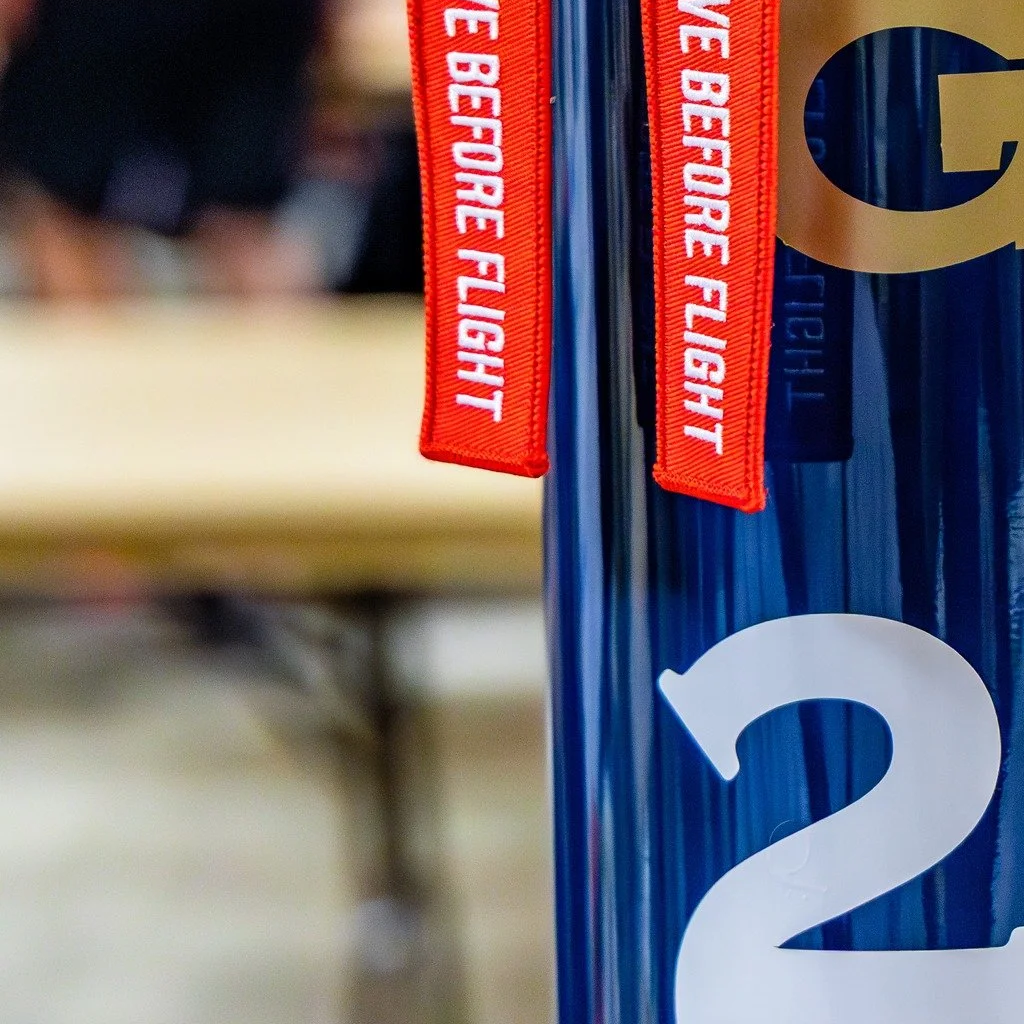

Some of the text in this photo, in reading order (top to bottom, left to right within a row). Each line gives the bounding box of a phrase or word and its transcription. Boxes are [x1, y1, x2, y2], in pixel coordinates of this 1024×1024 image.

[445, 50, 505, 240] BEFORE
[679, 68, 733, 266] BEFORE
[455, 248, 507, 423] FLIGHT
[682, 274, 729, 456] FLIGHT
